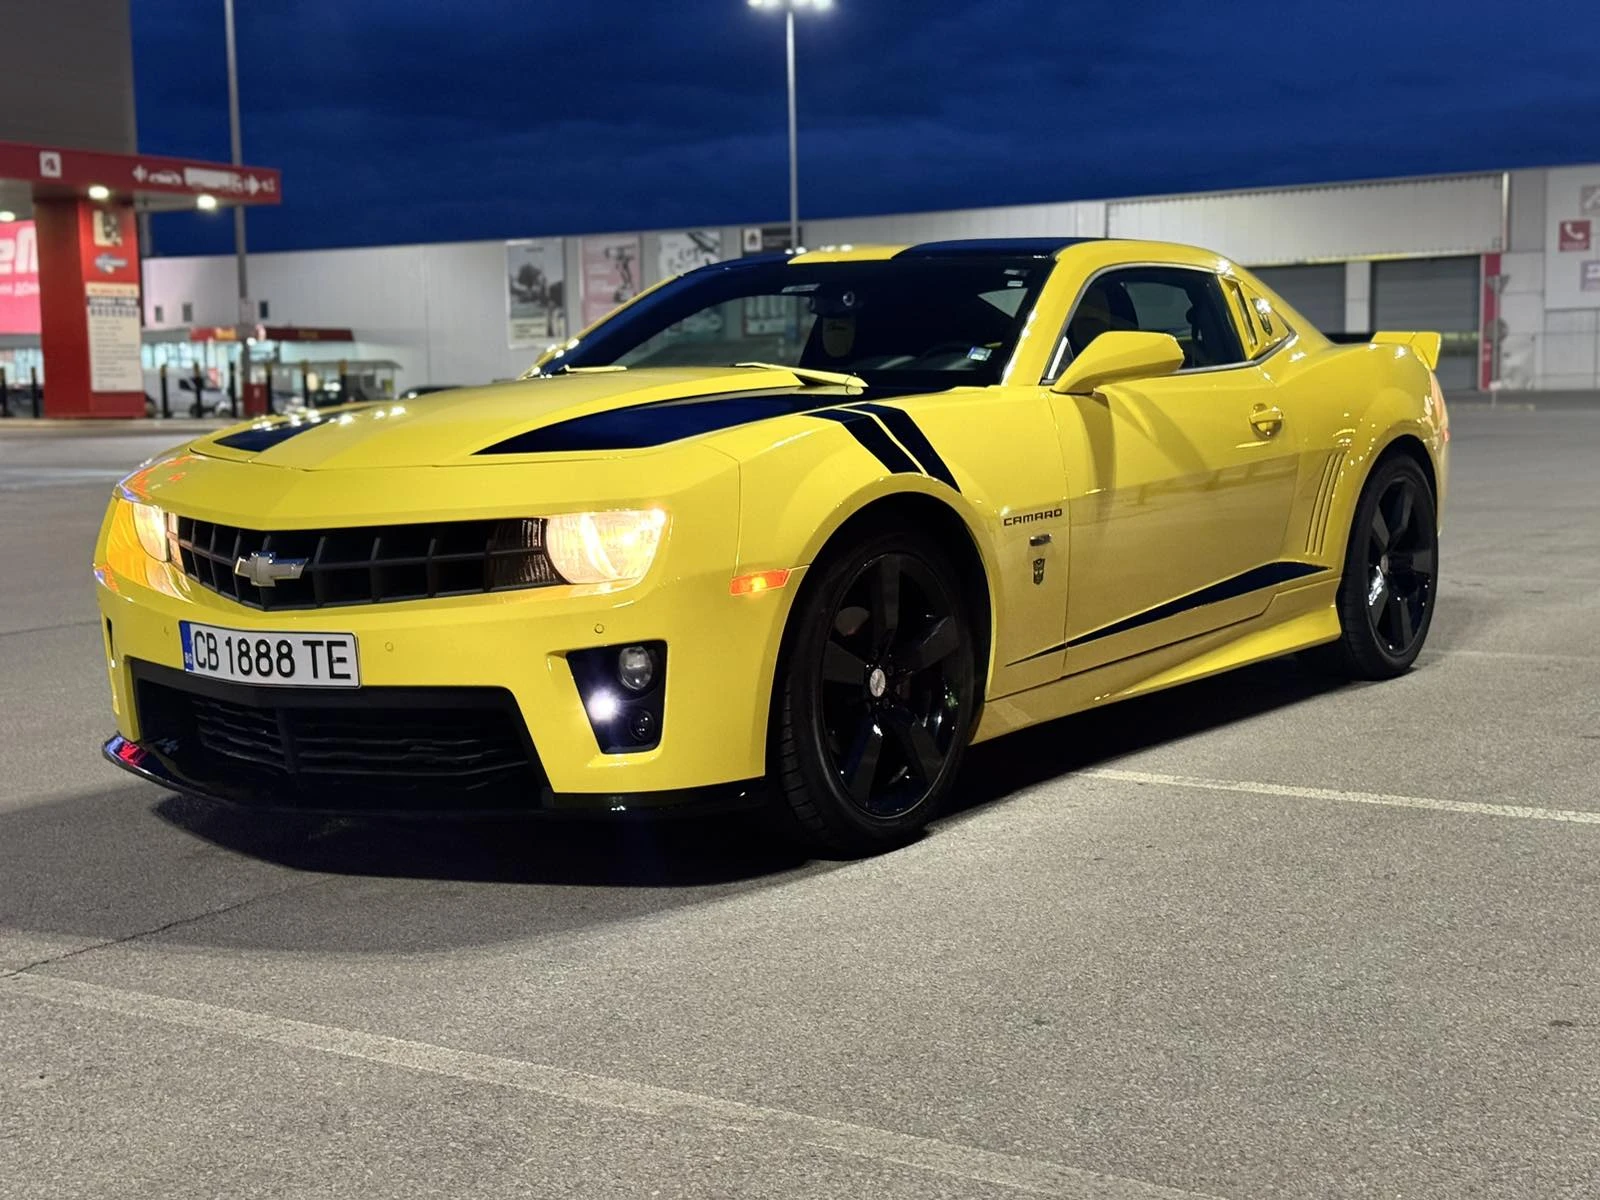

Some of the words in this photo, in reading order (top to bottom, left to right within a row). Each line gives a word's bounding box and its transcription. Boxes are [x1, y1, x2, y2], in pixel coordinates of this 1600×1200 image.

[1003, 508, 1063, 527] CAMARO
[194, 630, 220, 671] CB
[225, 635, 296, 679] 1888
[302, 639, 352, 680] TE
